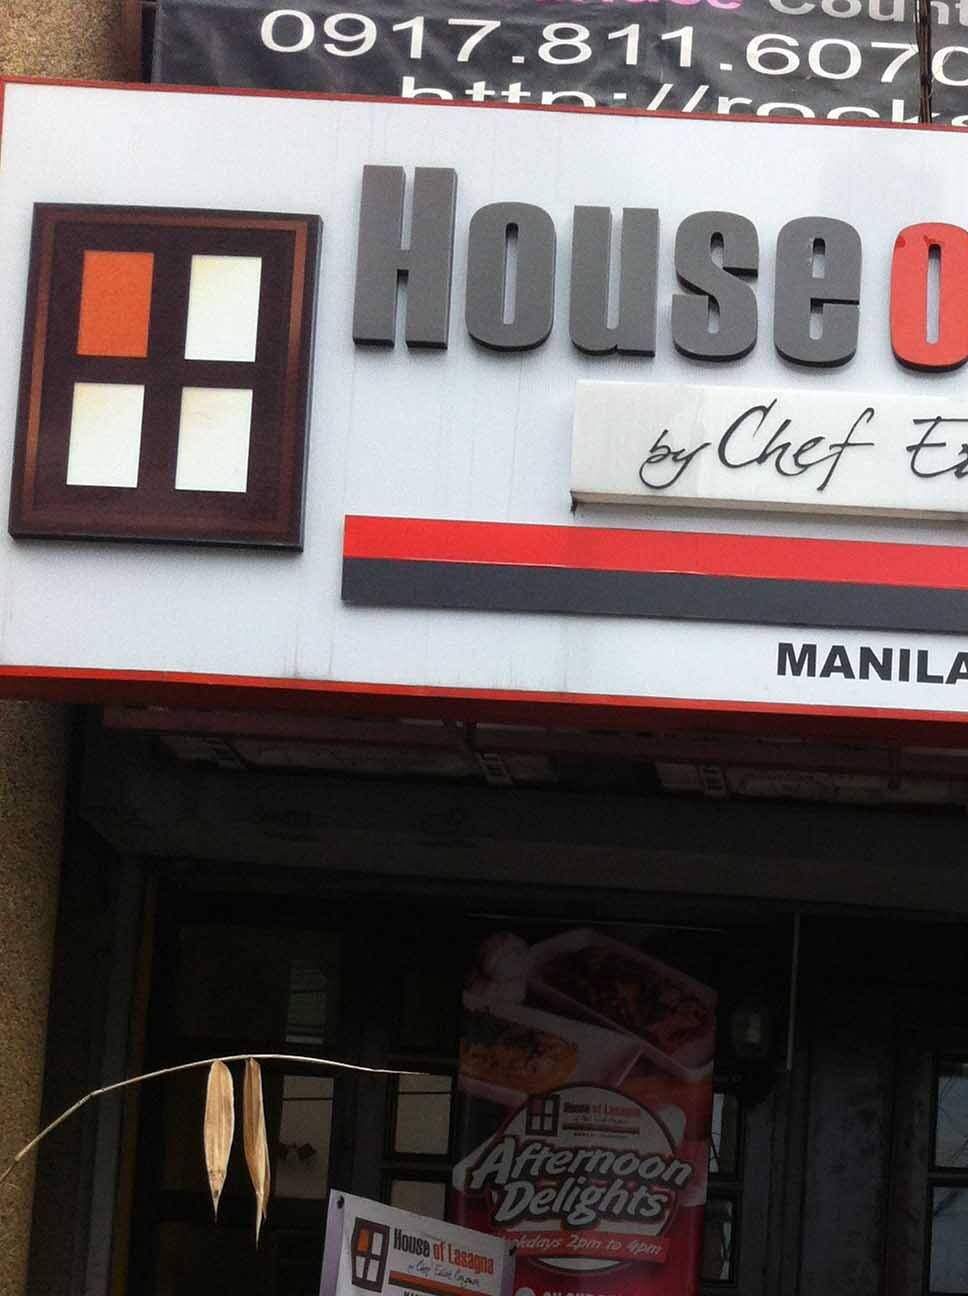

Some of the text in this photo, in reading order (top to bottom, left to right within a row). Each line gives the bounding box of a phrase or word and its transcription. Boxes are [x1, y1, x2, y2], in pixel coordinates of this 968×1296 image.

[352, 164, 863, 369] House
[640, 429, 710, 489] by
[716, 398, 876, 493] Chef
[470, 1136, 693, 1190] Afternoon
[493, 1176, 669, 1227] Delights
[433, 1239, 446, 1262] of
